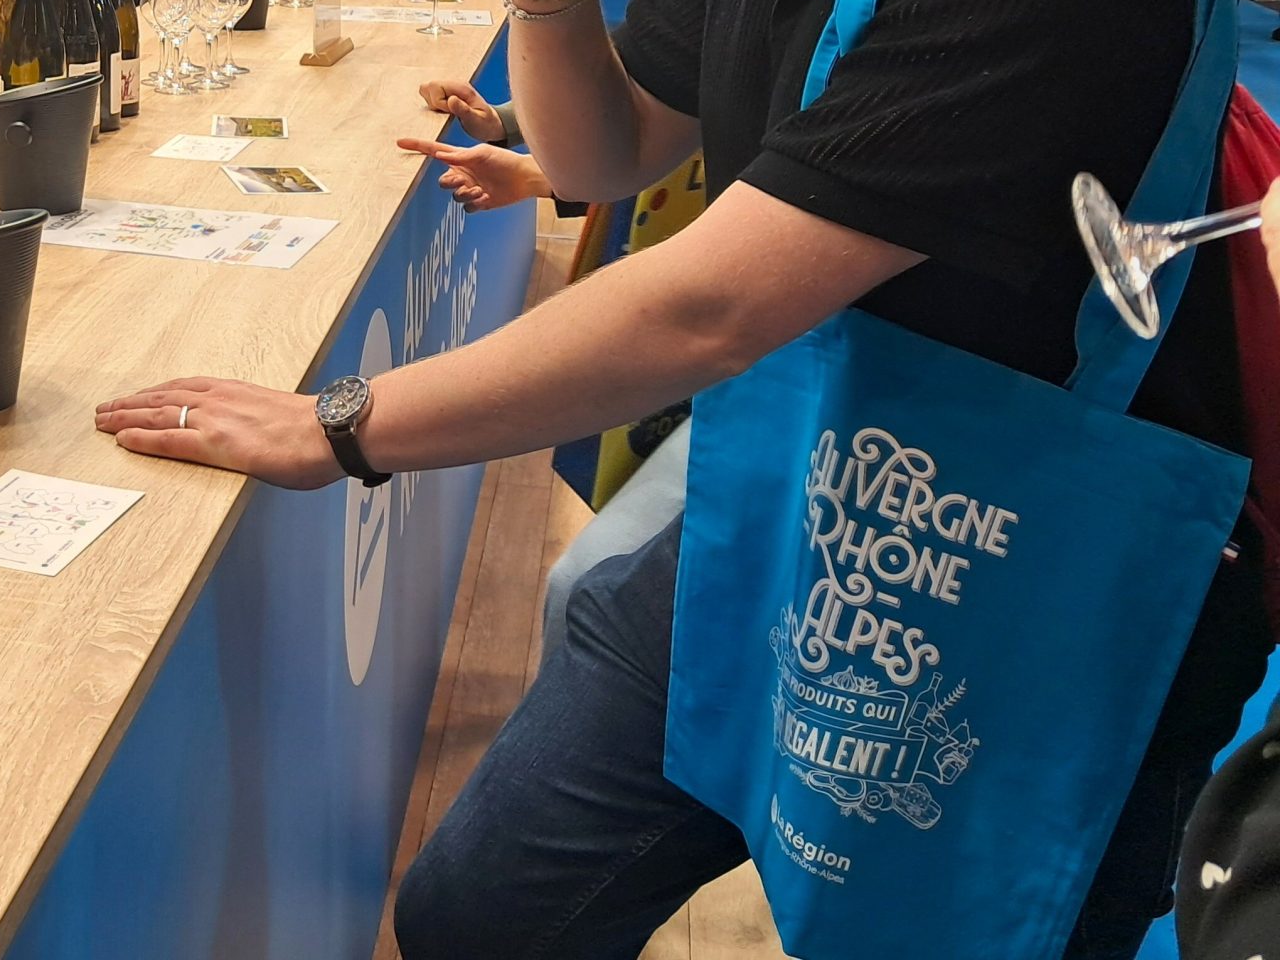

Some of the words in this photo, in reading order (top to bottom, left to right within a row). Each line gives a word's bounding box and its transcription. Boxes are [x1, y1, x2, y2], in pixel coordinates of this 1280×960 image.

[806, 427, 1019, 558] AUVERGNE
[807, 484, 971, 607] RHÔNE
[794, 577, 940, 686] ALPES
[862, 702, 897, 722] QUI
[775, 826, 845, 884] e-Rhône-Alpes
[784, 821, 851, 872] Région
